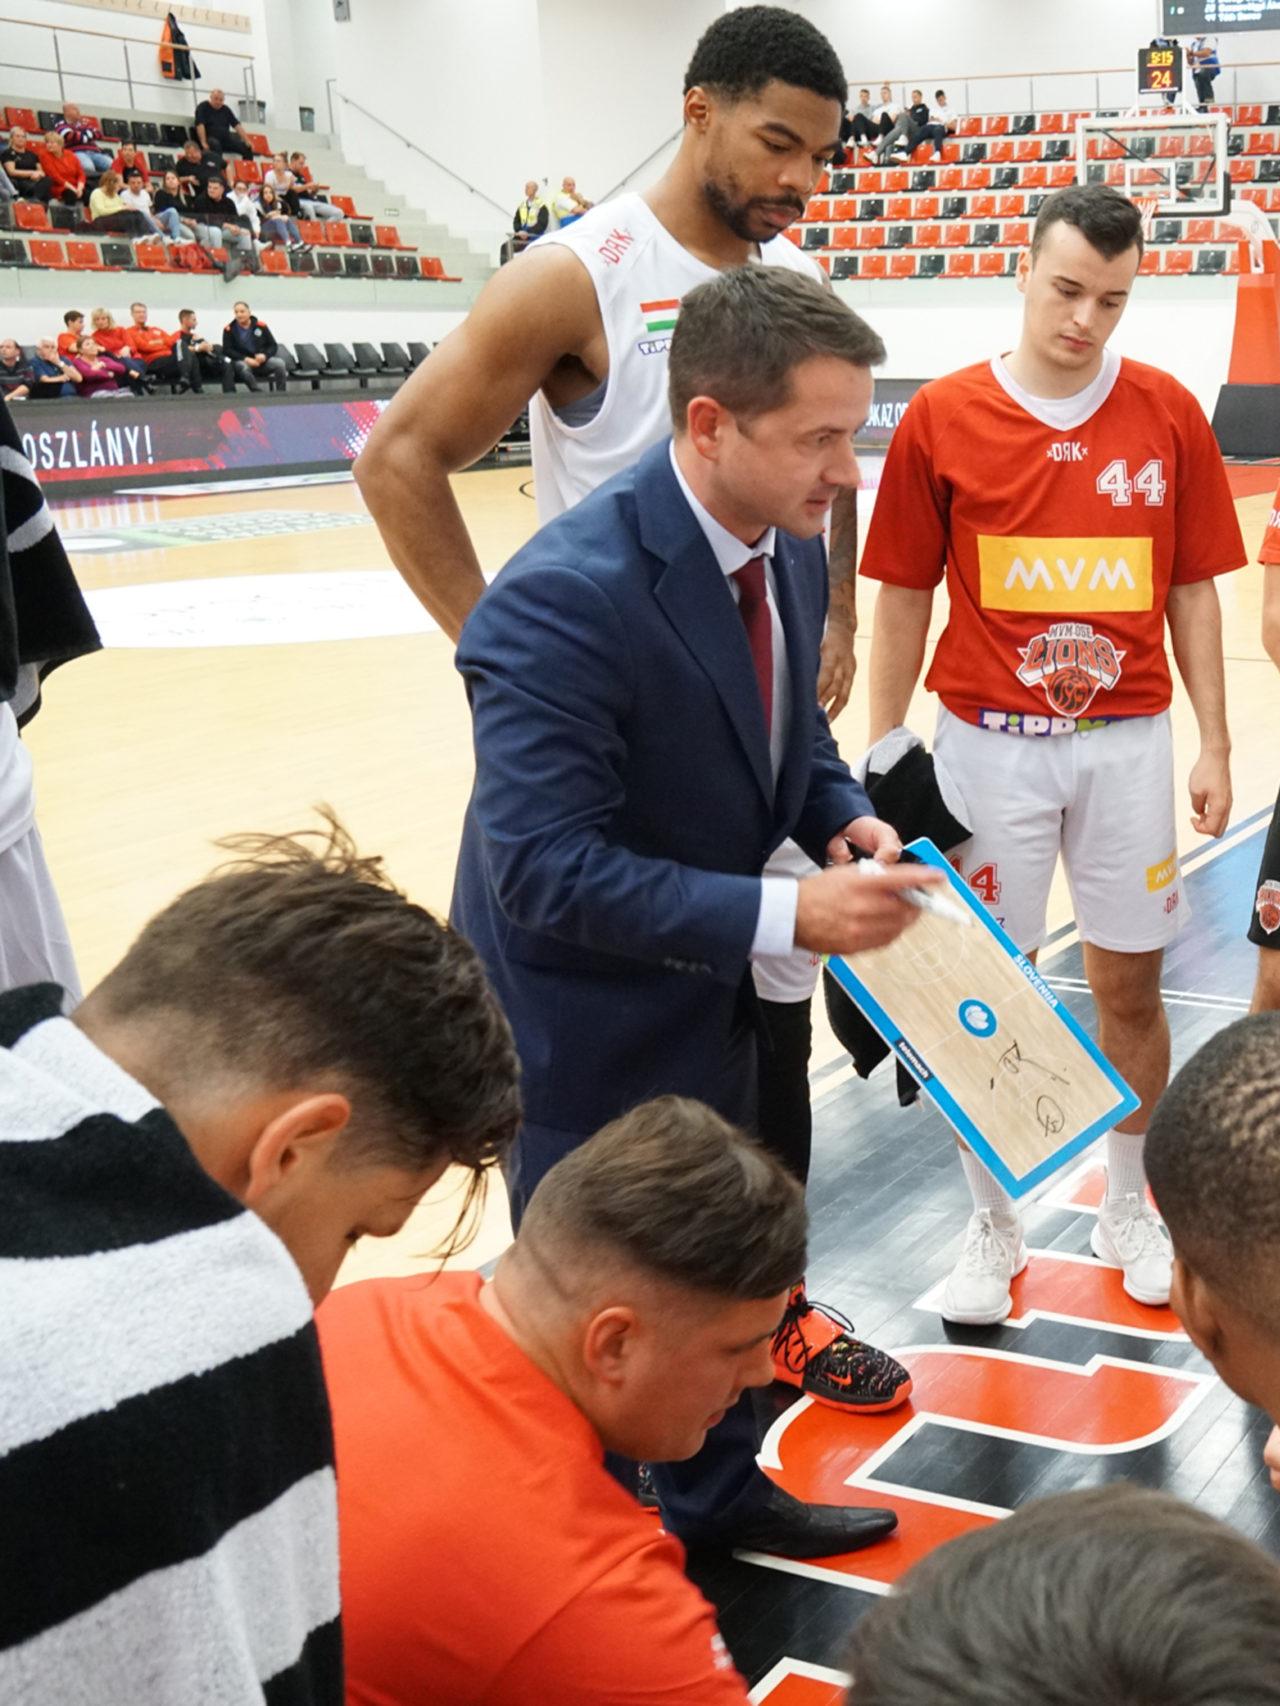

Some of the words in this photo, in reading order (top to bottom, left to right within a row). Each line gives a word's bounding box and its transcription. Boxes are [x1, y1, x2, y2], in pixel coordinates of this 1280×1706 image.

[1151, 70, 1172, 89] 24
[1096, 459, 1167, 507] 44
[1004, 557, 1136, 591] MVM
[1024, 638, 1118, 678] LIONS
